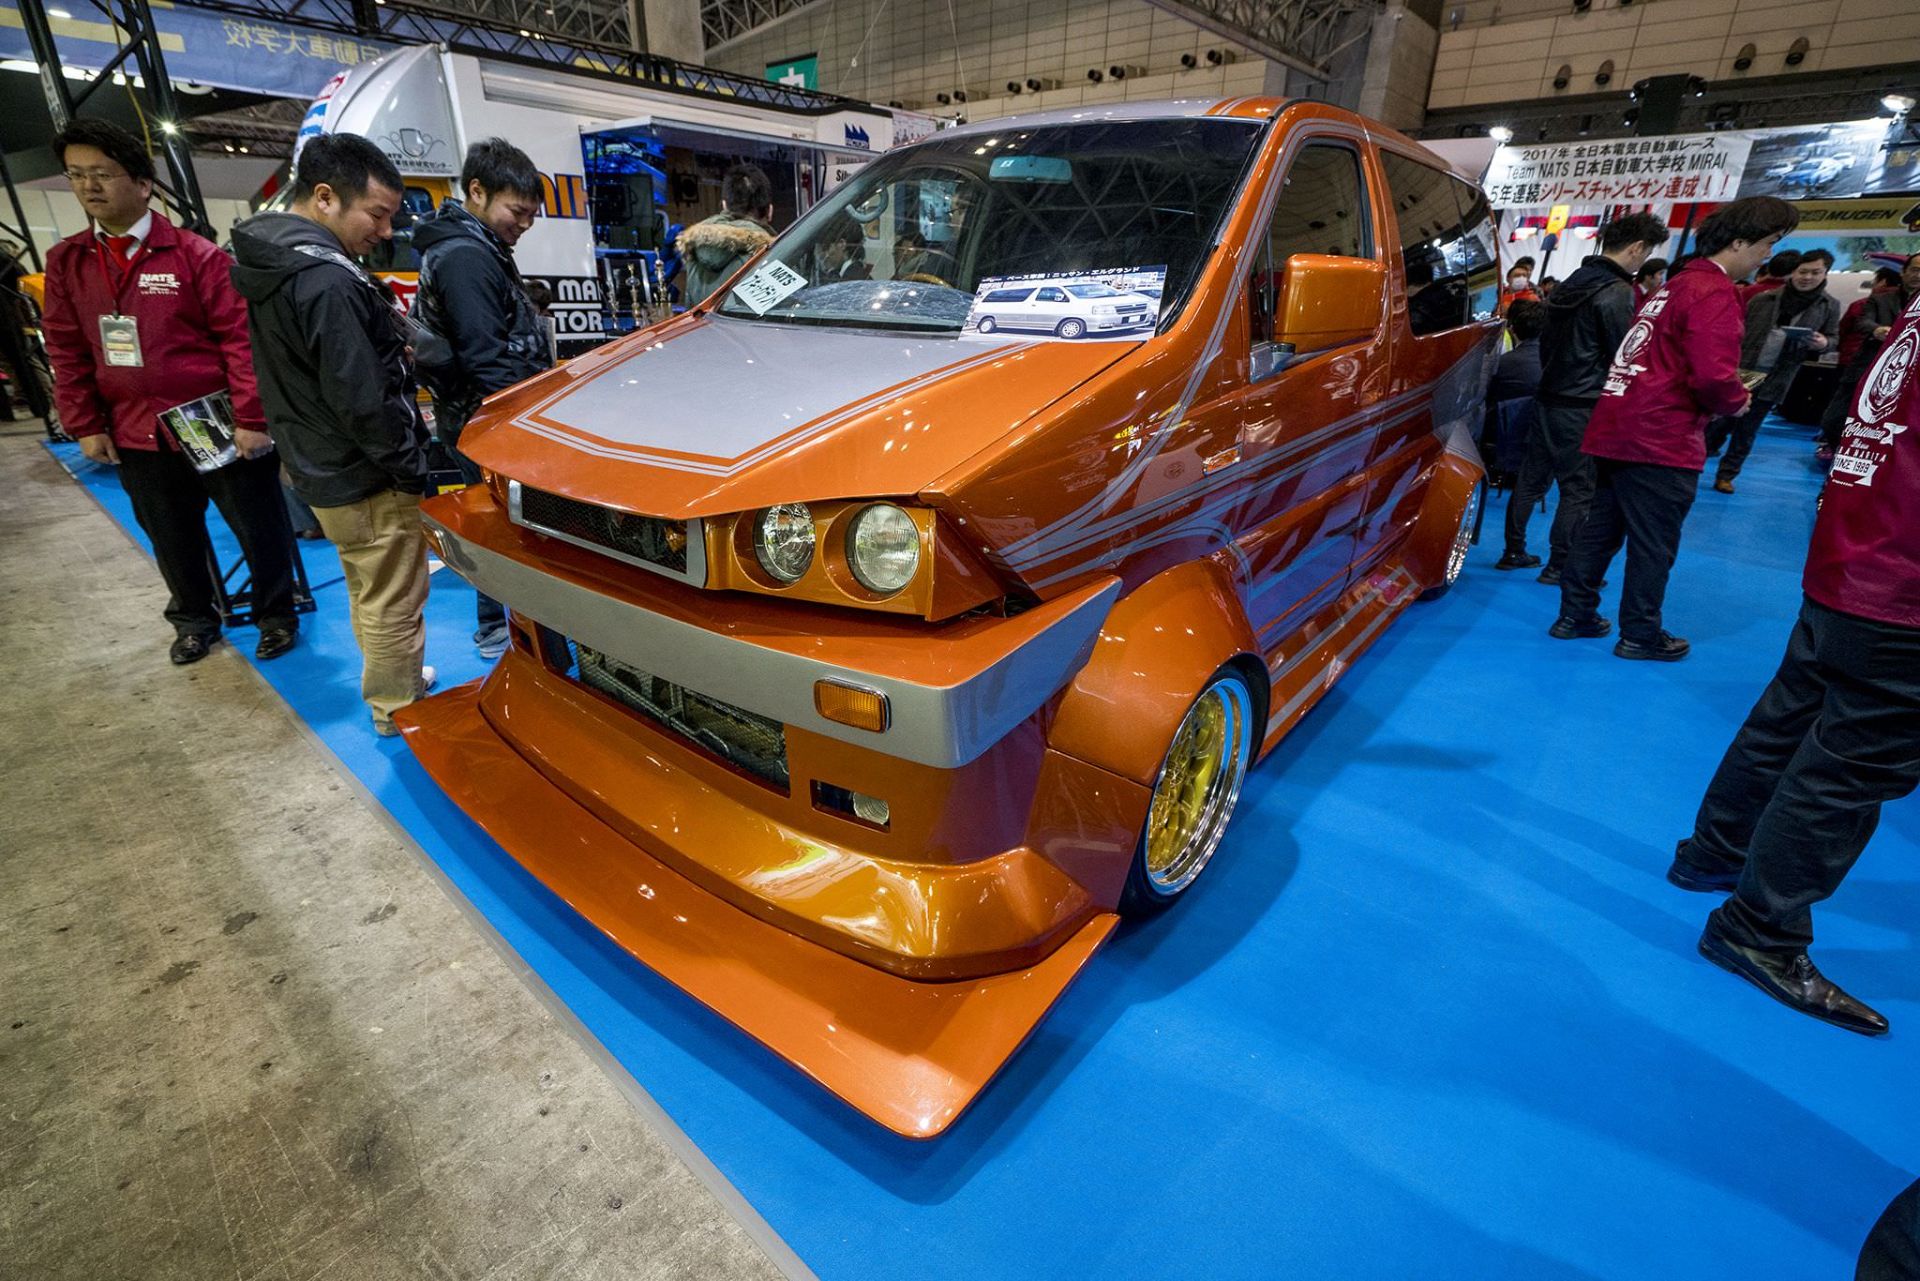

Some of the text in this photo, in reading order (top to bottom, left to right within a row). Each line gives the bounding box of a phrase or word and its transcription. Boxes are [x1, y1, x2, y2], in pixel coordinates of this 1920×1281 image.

[1521, 137, 1715, 161] 2017年 全日本電気自動車レース
[1507, 152, 1728, 180] Team NATS 日本自動車大学校 MIRAI
[1826, 209, 1898, 220] MUGEN
[140, 273, 175, 283] NATS
[768, 266, 797, 287] NATS
[554, 311, 604, 332] TOR
